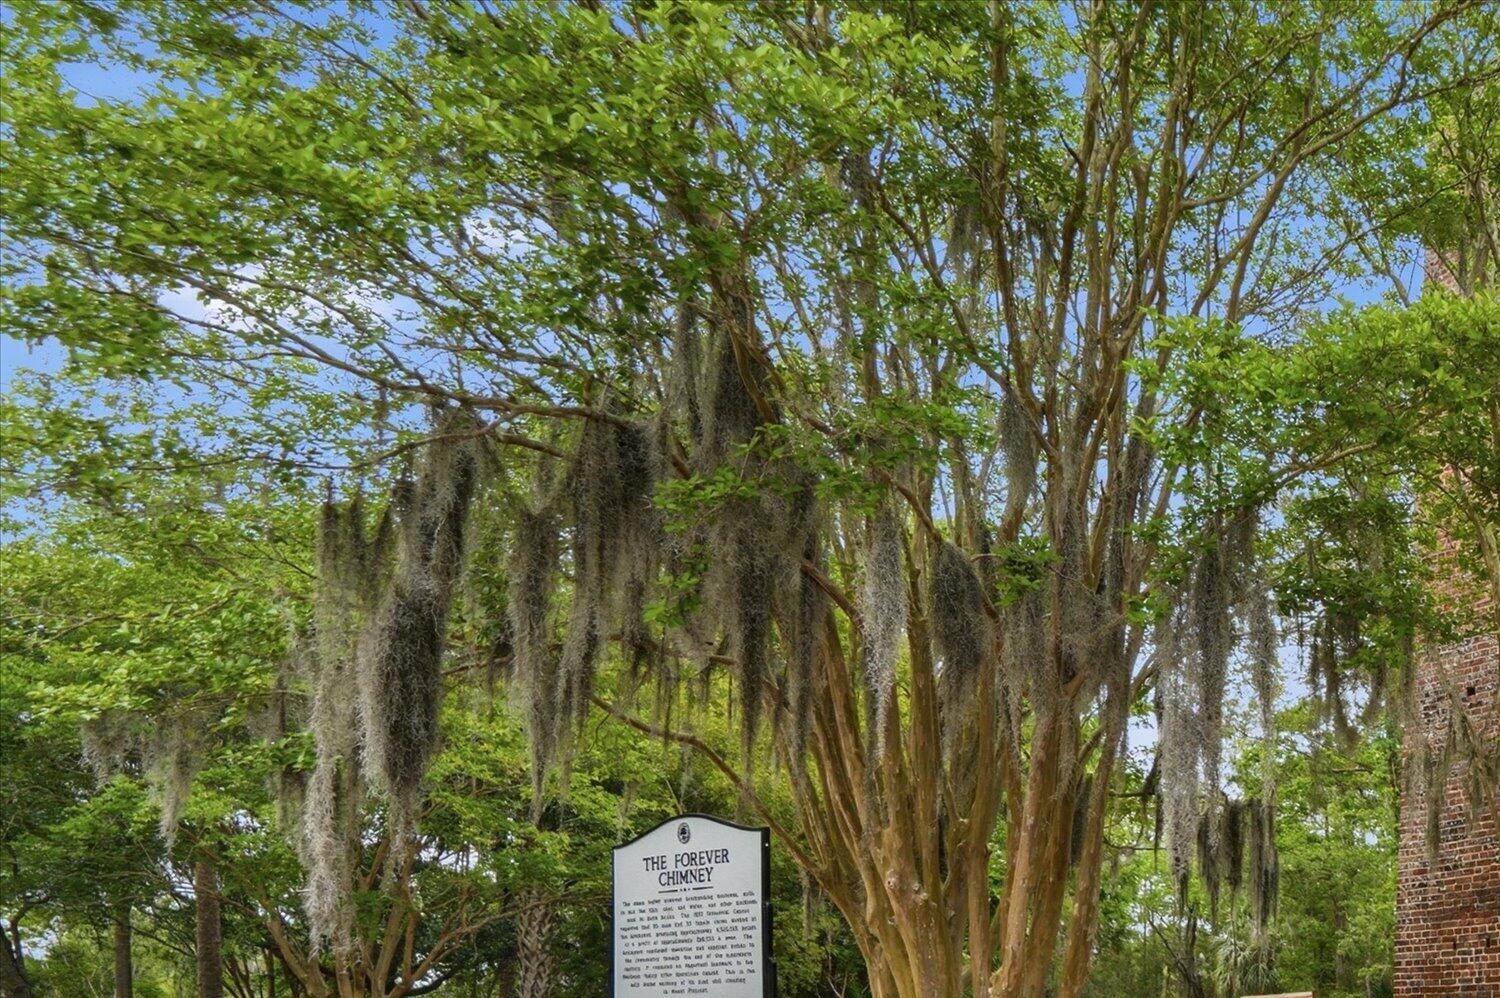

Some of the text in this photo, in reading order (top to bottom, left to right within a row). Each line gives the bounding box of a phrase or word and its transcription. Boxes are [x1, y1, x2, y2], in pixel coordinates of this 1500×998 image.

[643, 848, 730, 872] THE FOREVER
[658, 866, 714, 886] CHIMNEY
